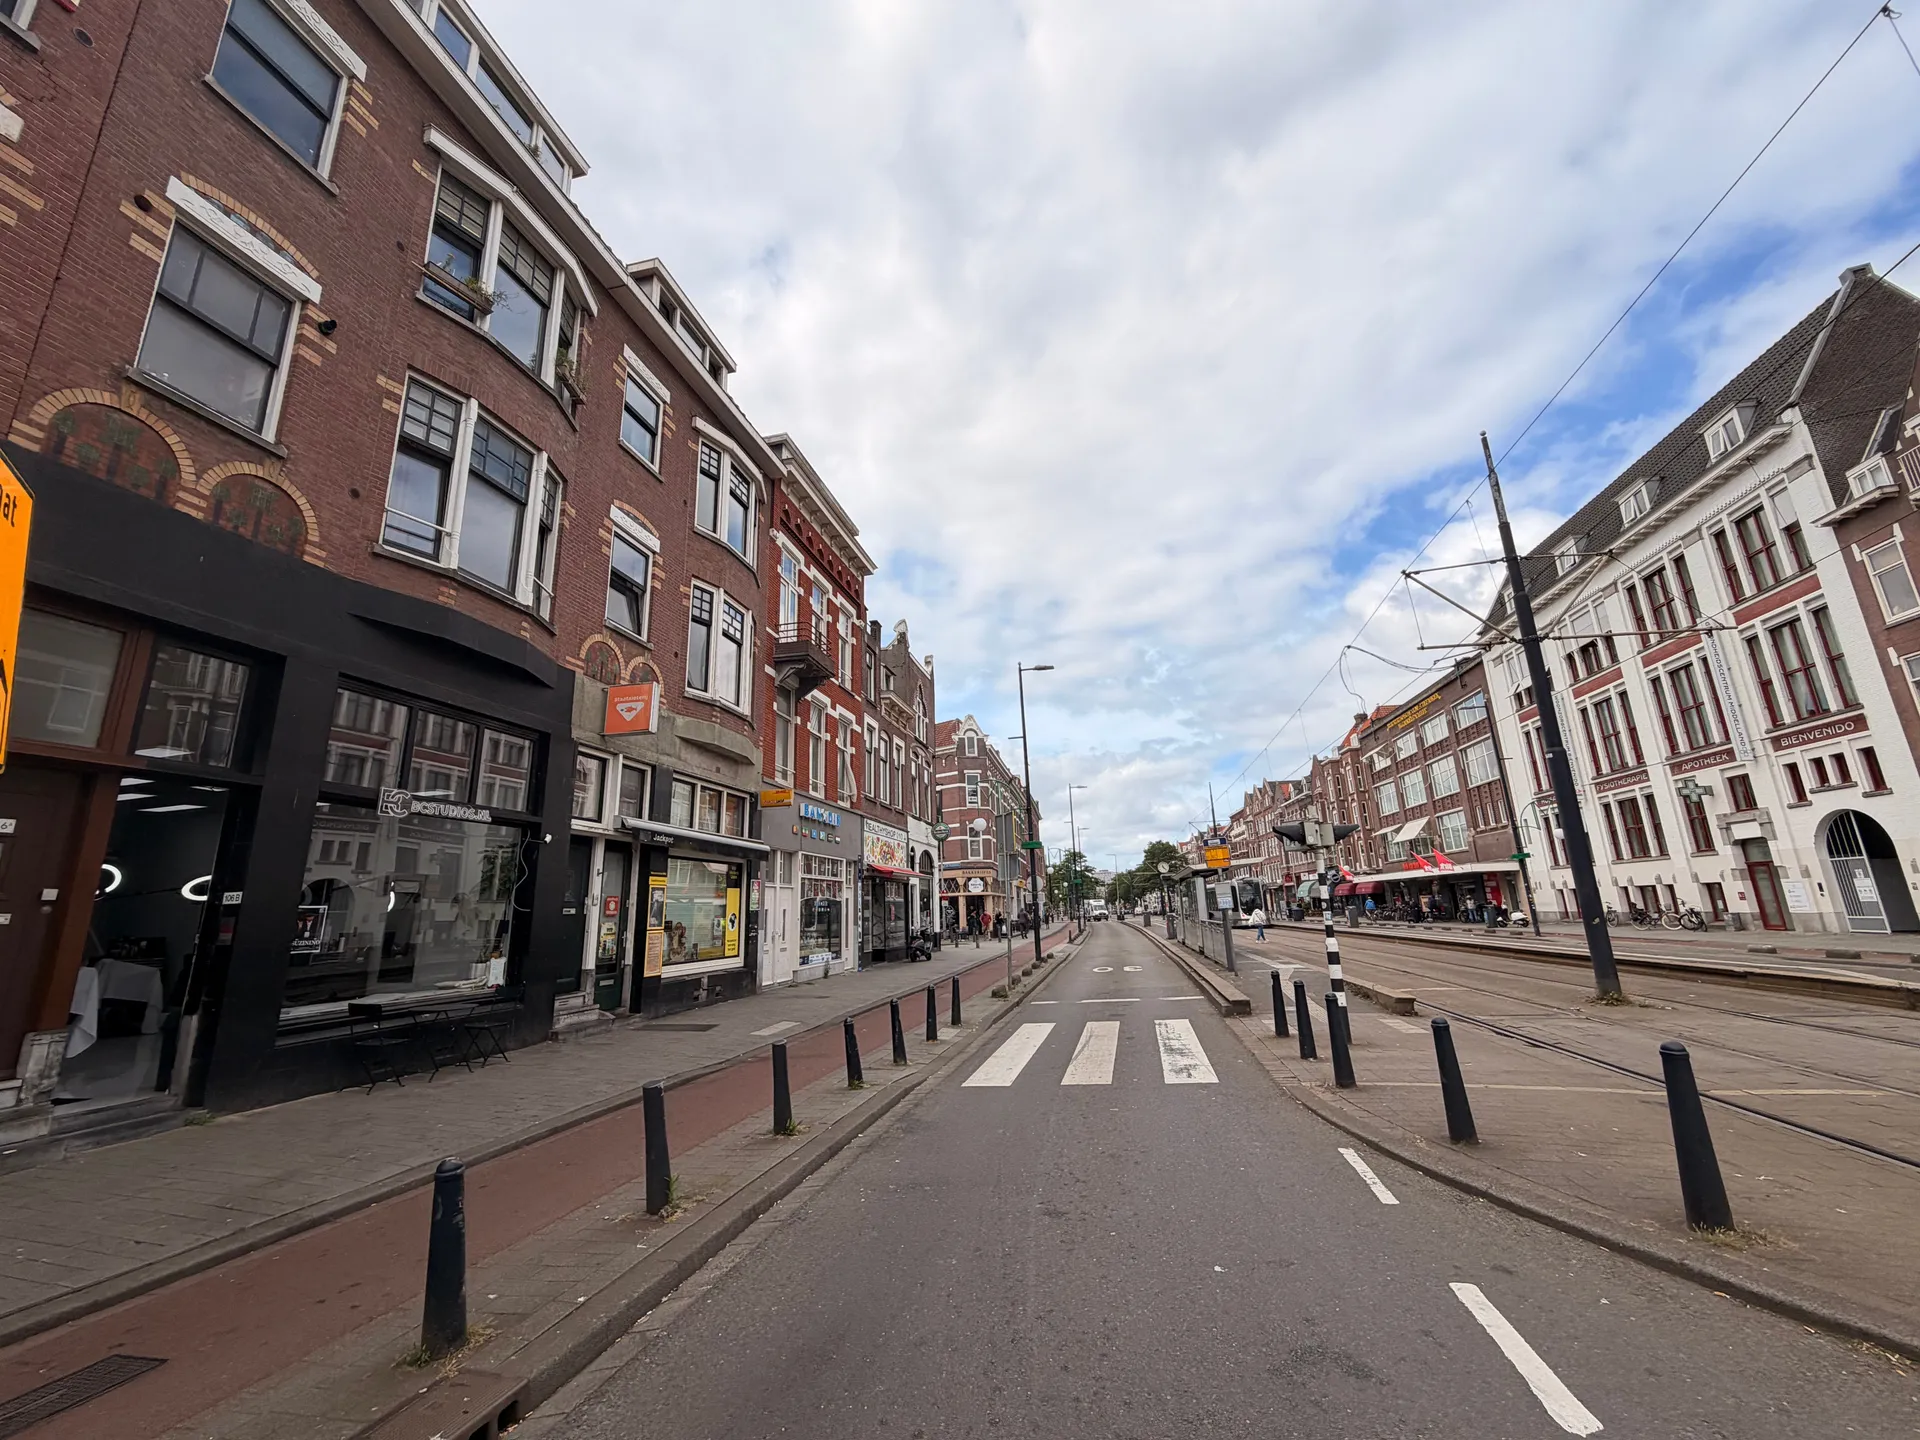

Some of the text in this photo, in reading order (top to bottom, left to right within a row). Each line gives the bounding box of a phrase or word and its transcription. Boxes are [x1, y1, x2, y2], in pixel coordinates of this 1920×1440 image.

[1728, 701, 1746, 747] MIDDELLAND
[1780, 721, 1855, 746] BIENVENIDO
[1681, 752, 1729, 771] APOTHEEK
[1596, 772, 1648, 791] FYSIOTHERAPIE
[411, 800, 492, 822] BCSTUDIOS.NL
[653, 833, 674, 845] Jackpot
